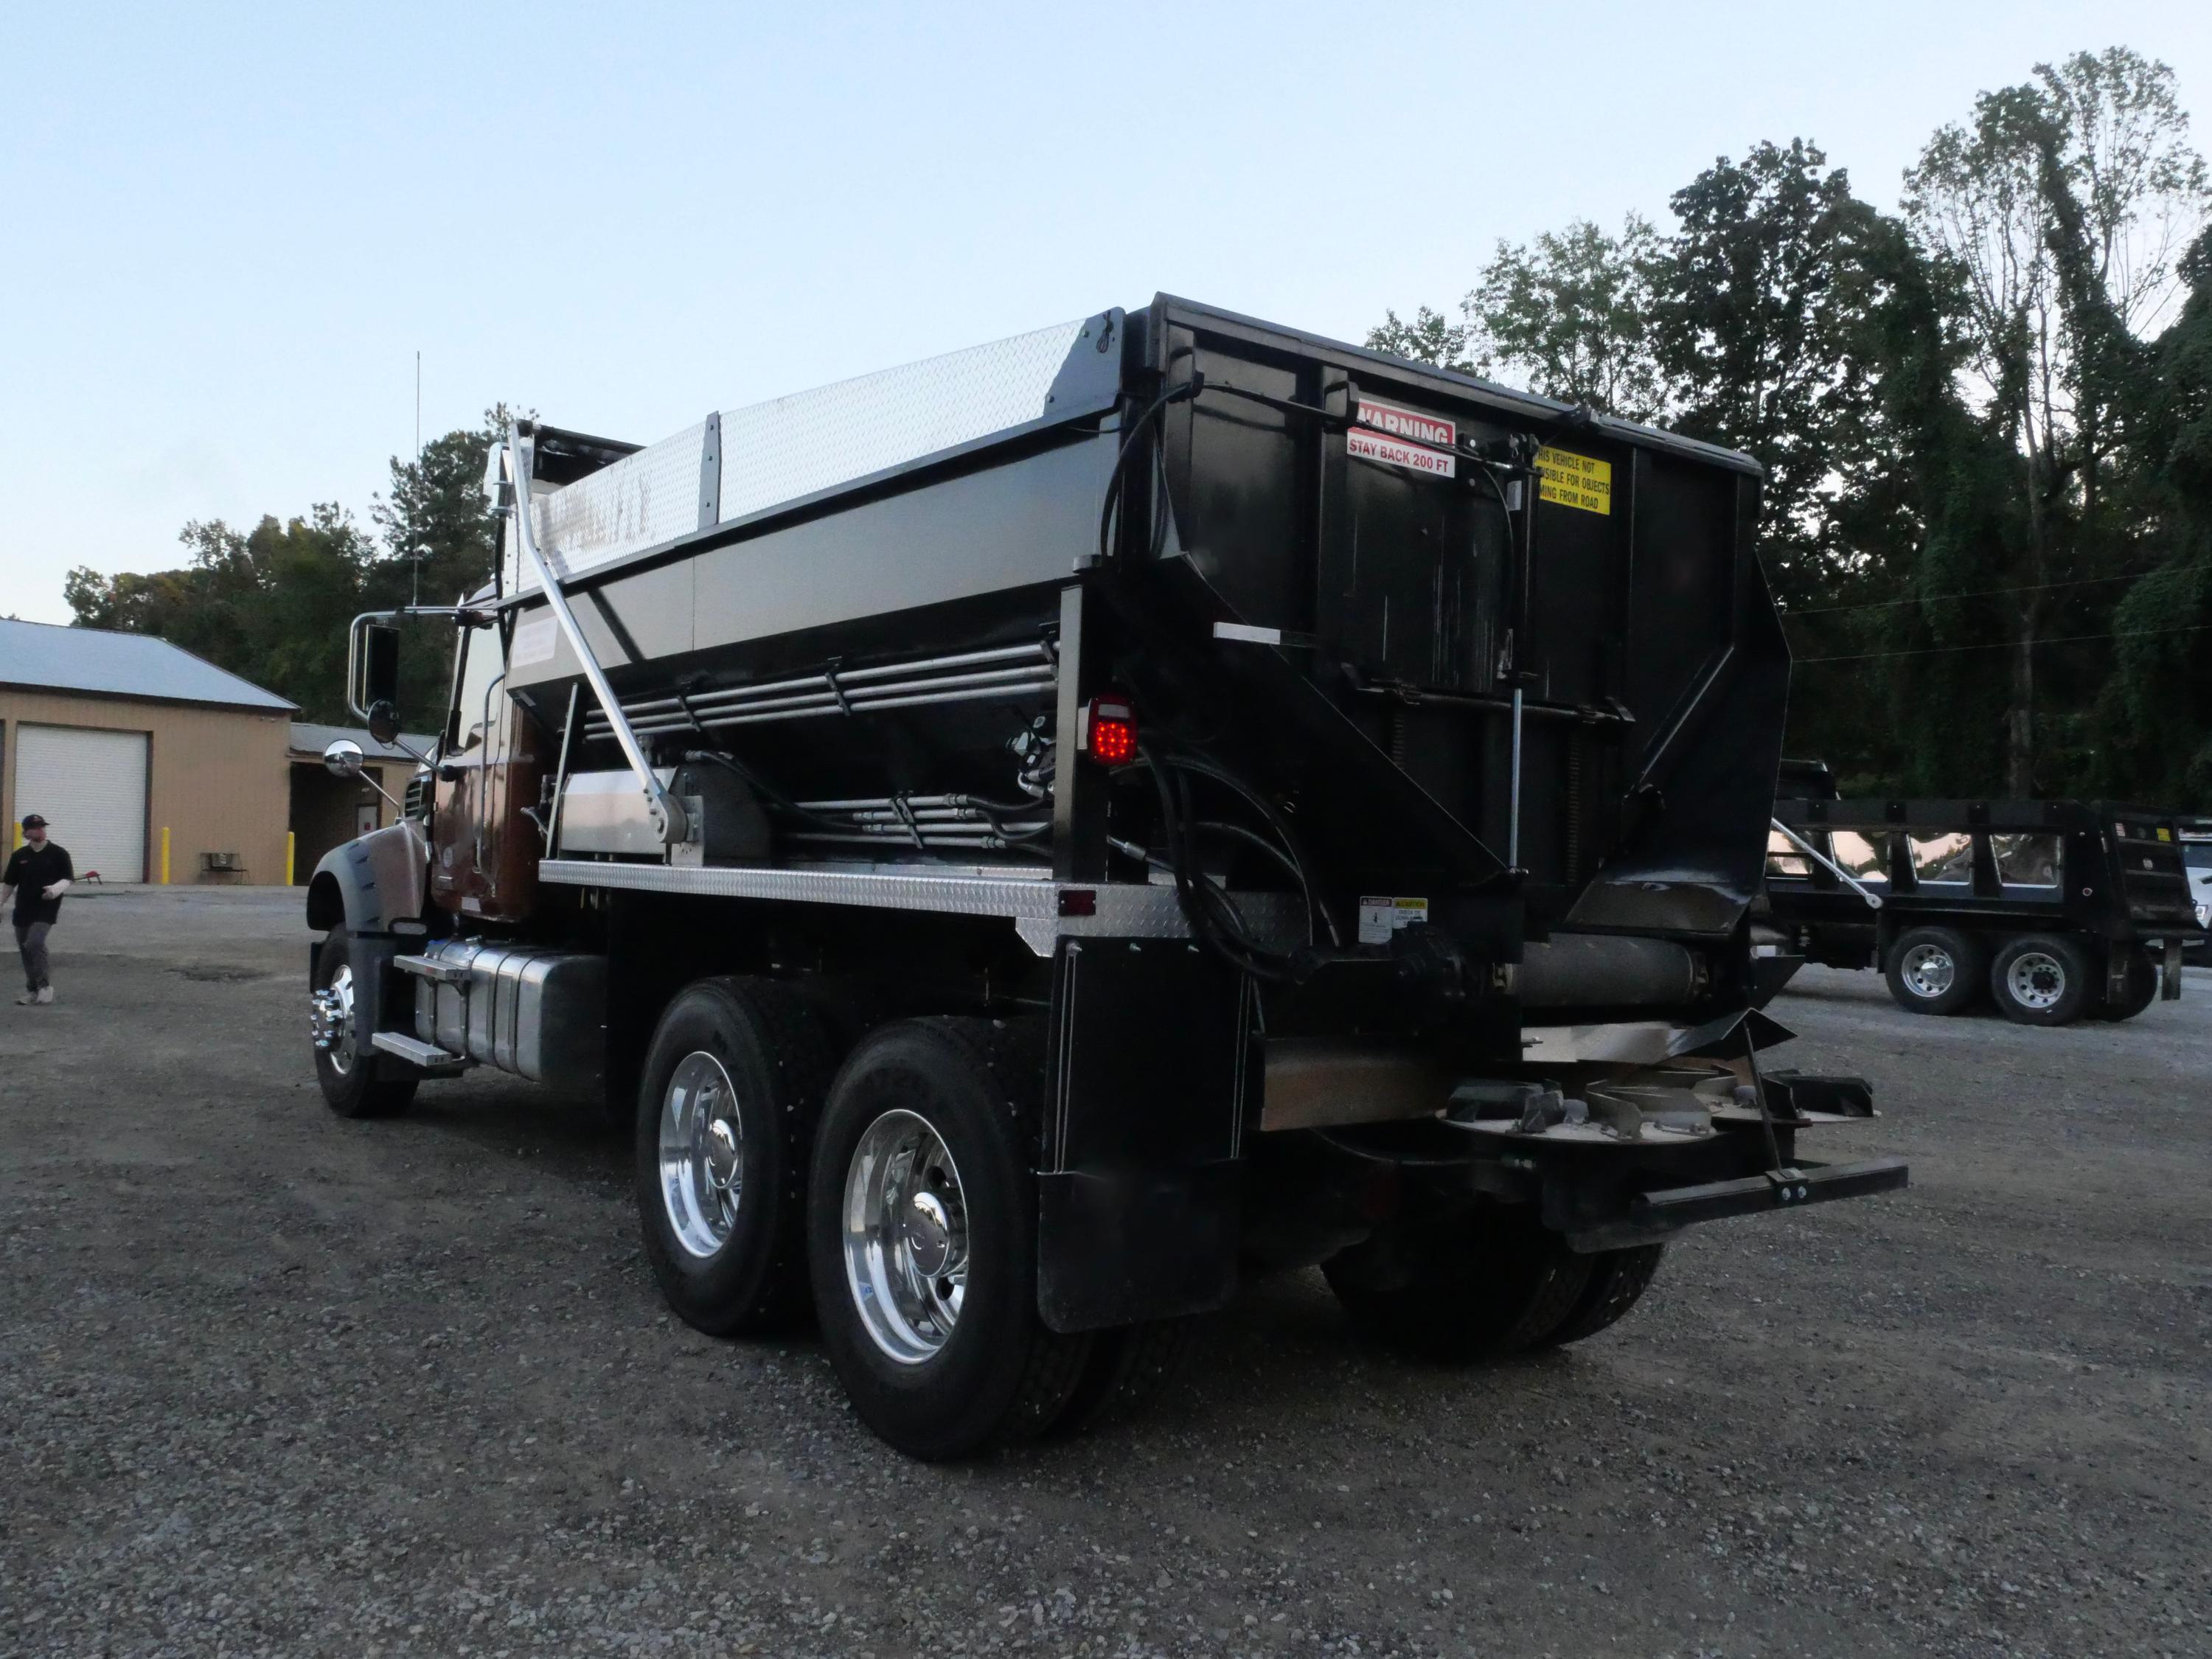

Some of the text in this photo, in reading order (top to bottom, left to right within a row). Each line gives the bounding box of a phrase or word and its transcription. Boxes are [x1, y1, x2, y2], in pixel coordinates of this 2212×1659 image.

[1349, 439, 1448, 473] STAY BACK 200 FT
[1538, 448, 1595, 474] HIS VEHICLE NOT
[1567, 473, 1579, 487] FOR
[1582, 477, 1610, 495] OBJECTS
[1559, 489, 1579, 504] FROM
[1581, 494, 1599, 509] ROAD
